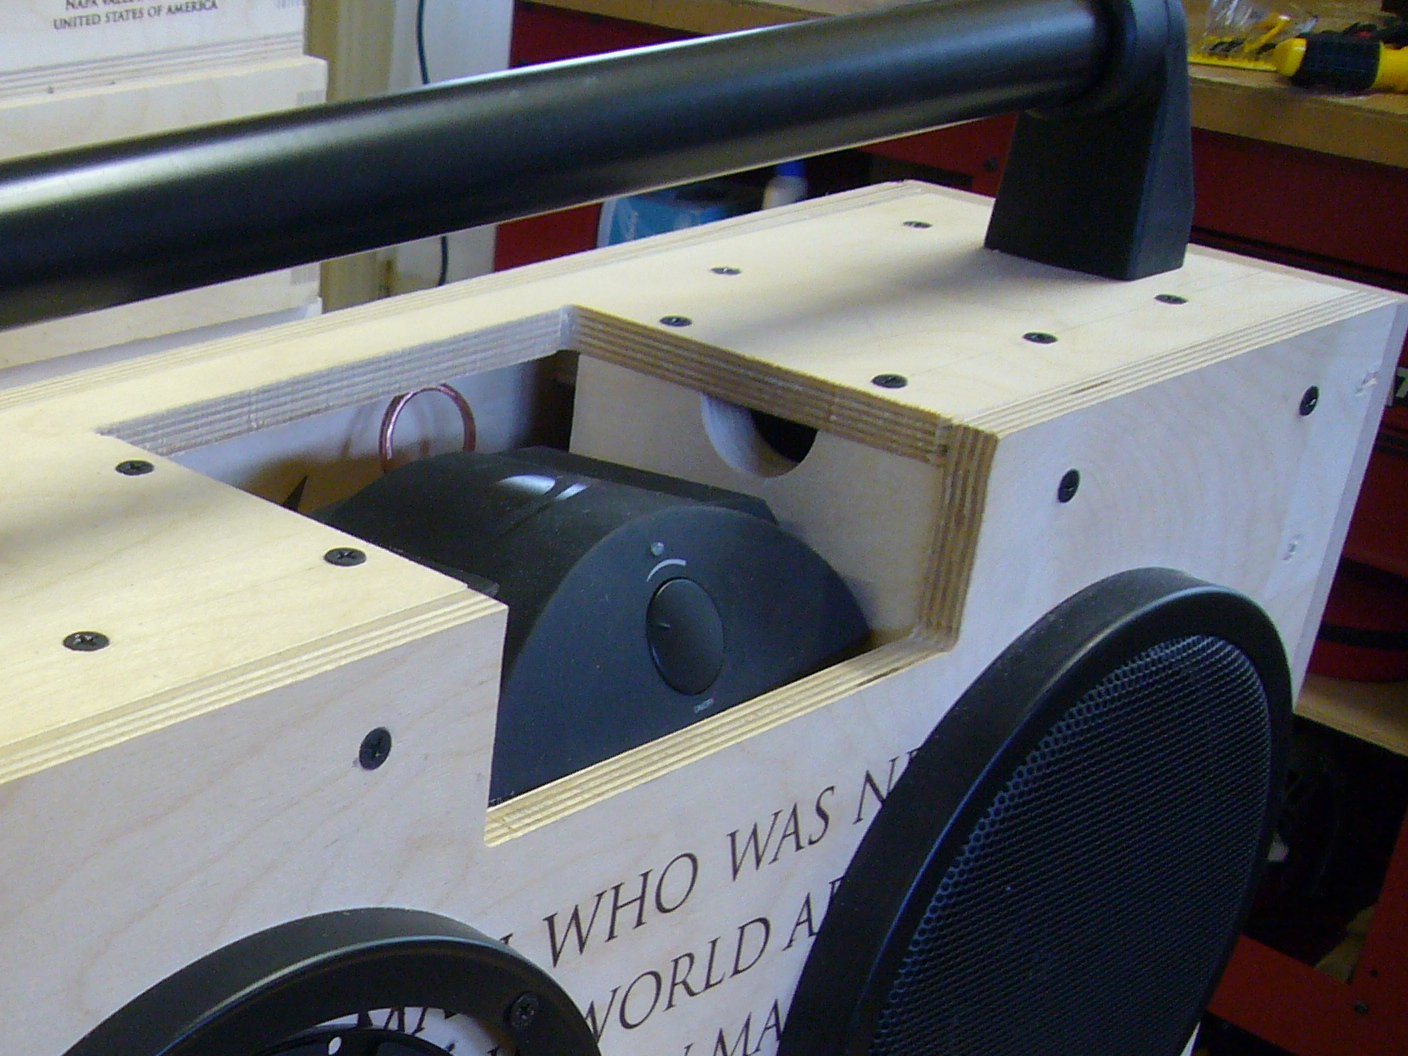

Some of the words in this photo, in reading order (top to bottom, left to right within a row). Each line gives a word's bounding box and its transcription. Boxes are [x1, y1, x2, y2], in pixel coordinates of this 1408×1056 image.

[53, 14, 101, 30] UNITED
[105, 7, 143, 23] STATES
[147, 5, 163, 18] OF
[166, 0, 219, 15] AMERICA
[542, 852, 699, 969] WHO
[725, 785, 836, 883] WAS
